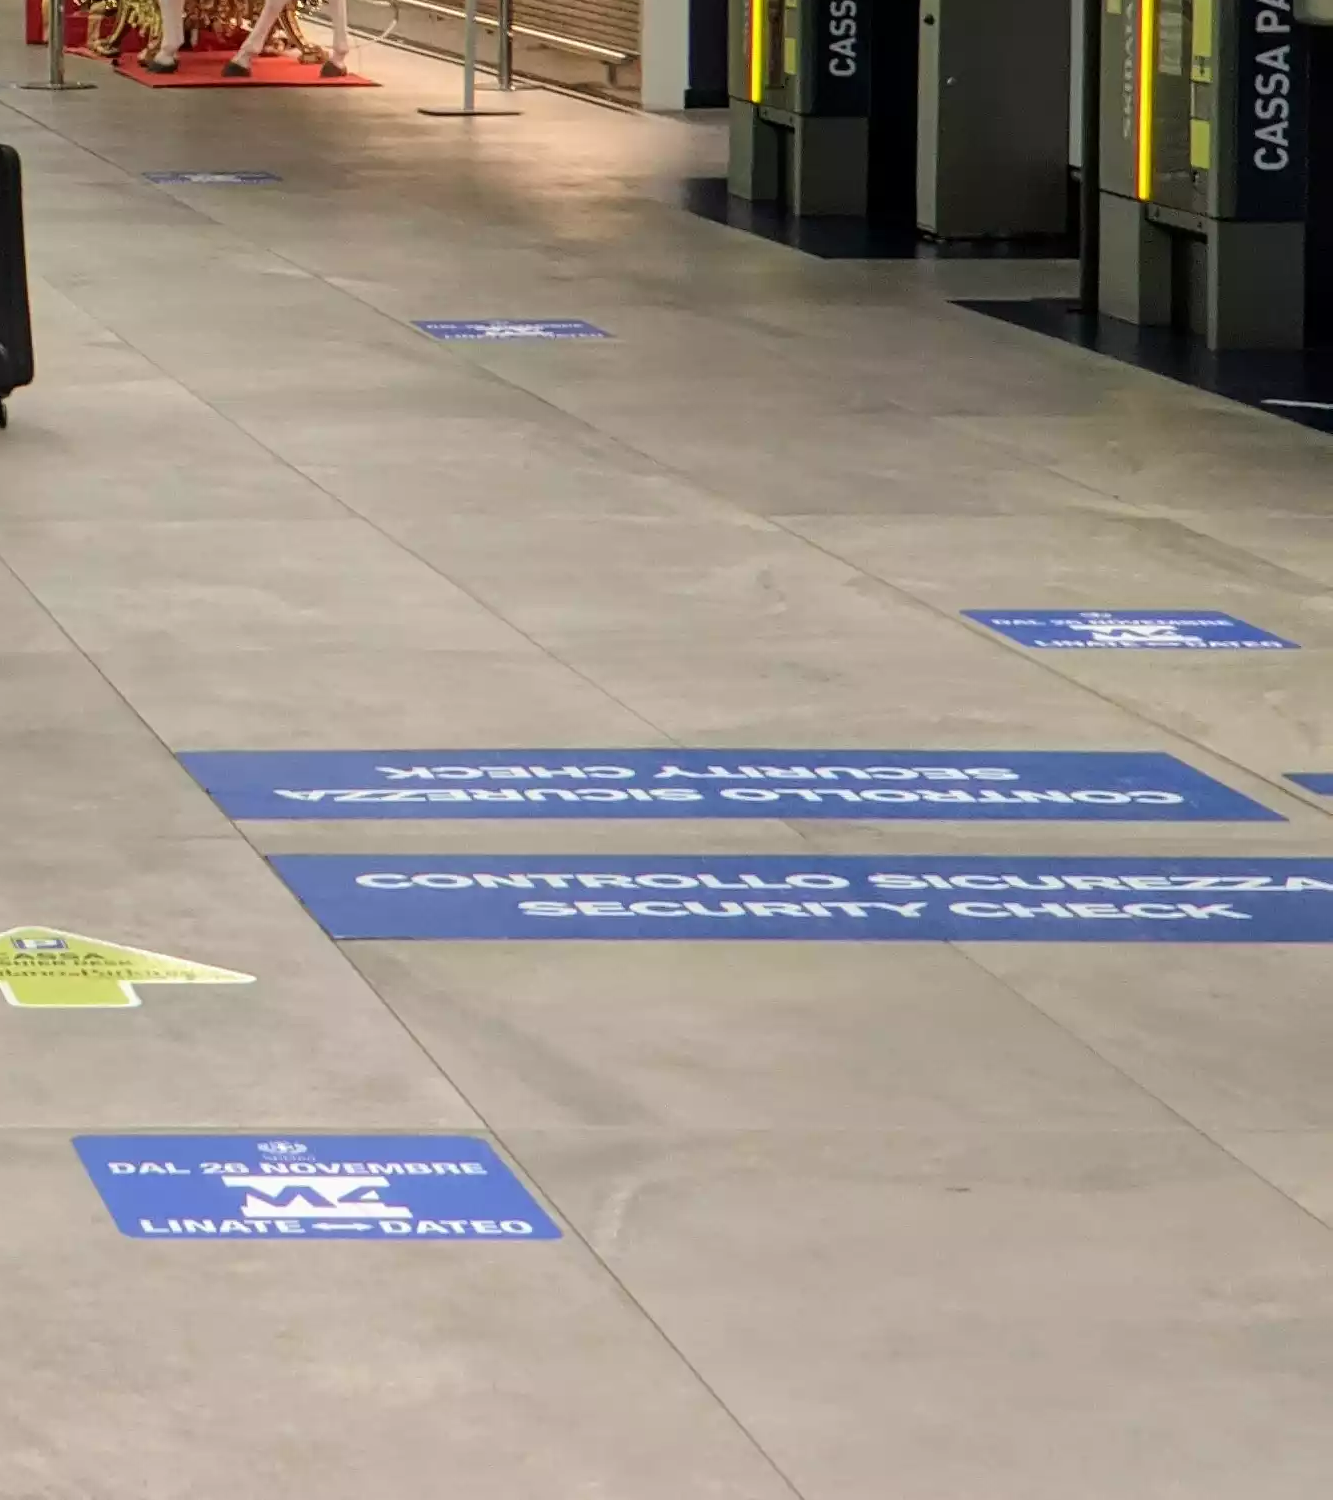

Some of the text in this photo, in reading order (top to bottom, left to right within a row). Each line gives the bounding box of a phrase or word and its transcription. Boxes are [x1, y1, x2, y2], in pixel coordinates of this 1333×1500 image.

[1254, 36, 1290, 172] CASSA
[375, 765, 1020, 781] SECURITY CHECK
[273, 787, 1184, 804] CONTROLLO SICUREZZA
[355, 872, 1333, 893] CONTROLLO SICUREZZA
[518, 900, 1253, 920] SECURITY CHECK
[108, 1161, 191, 1176] DAL
[260, 1161, 488, 1176] NOVEMBRE
[140, 1219, 534, 1235] LINATE DATEO
